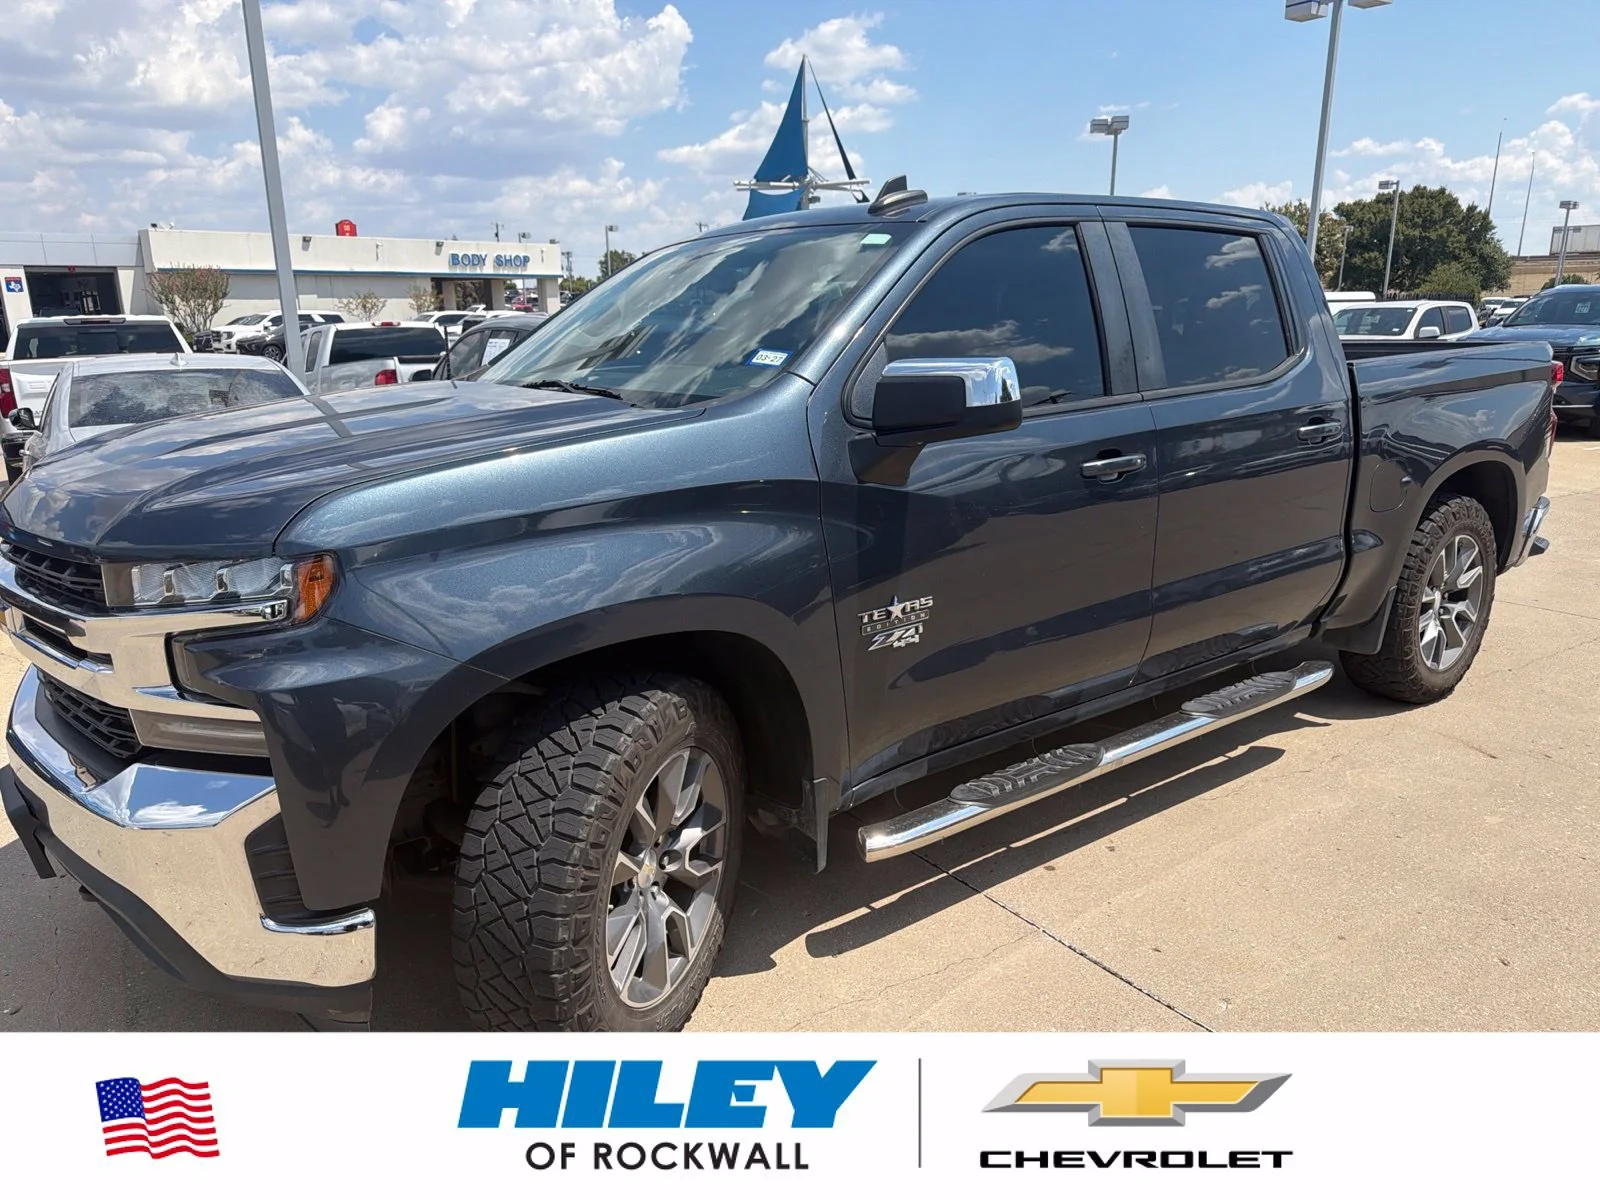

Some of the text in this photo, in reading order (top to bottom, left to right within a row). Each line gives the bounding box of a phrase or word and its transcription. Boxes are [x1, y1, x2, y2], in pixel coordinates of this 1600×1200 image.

[449, 253, 531, 267] BODY SHOP
[866, 612, 926, 632] EDITION
[867, 622, 924, 651] Z71
